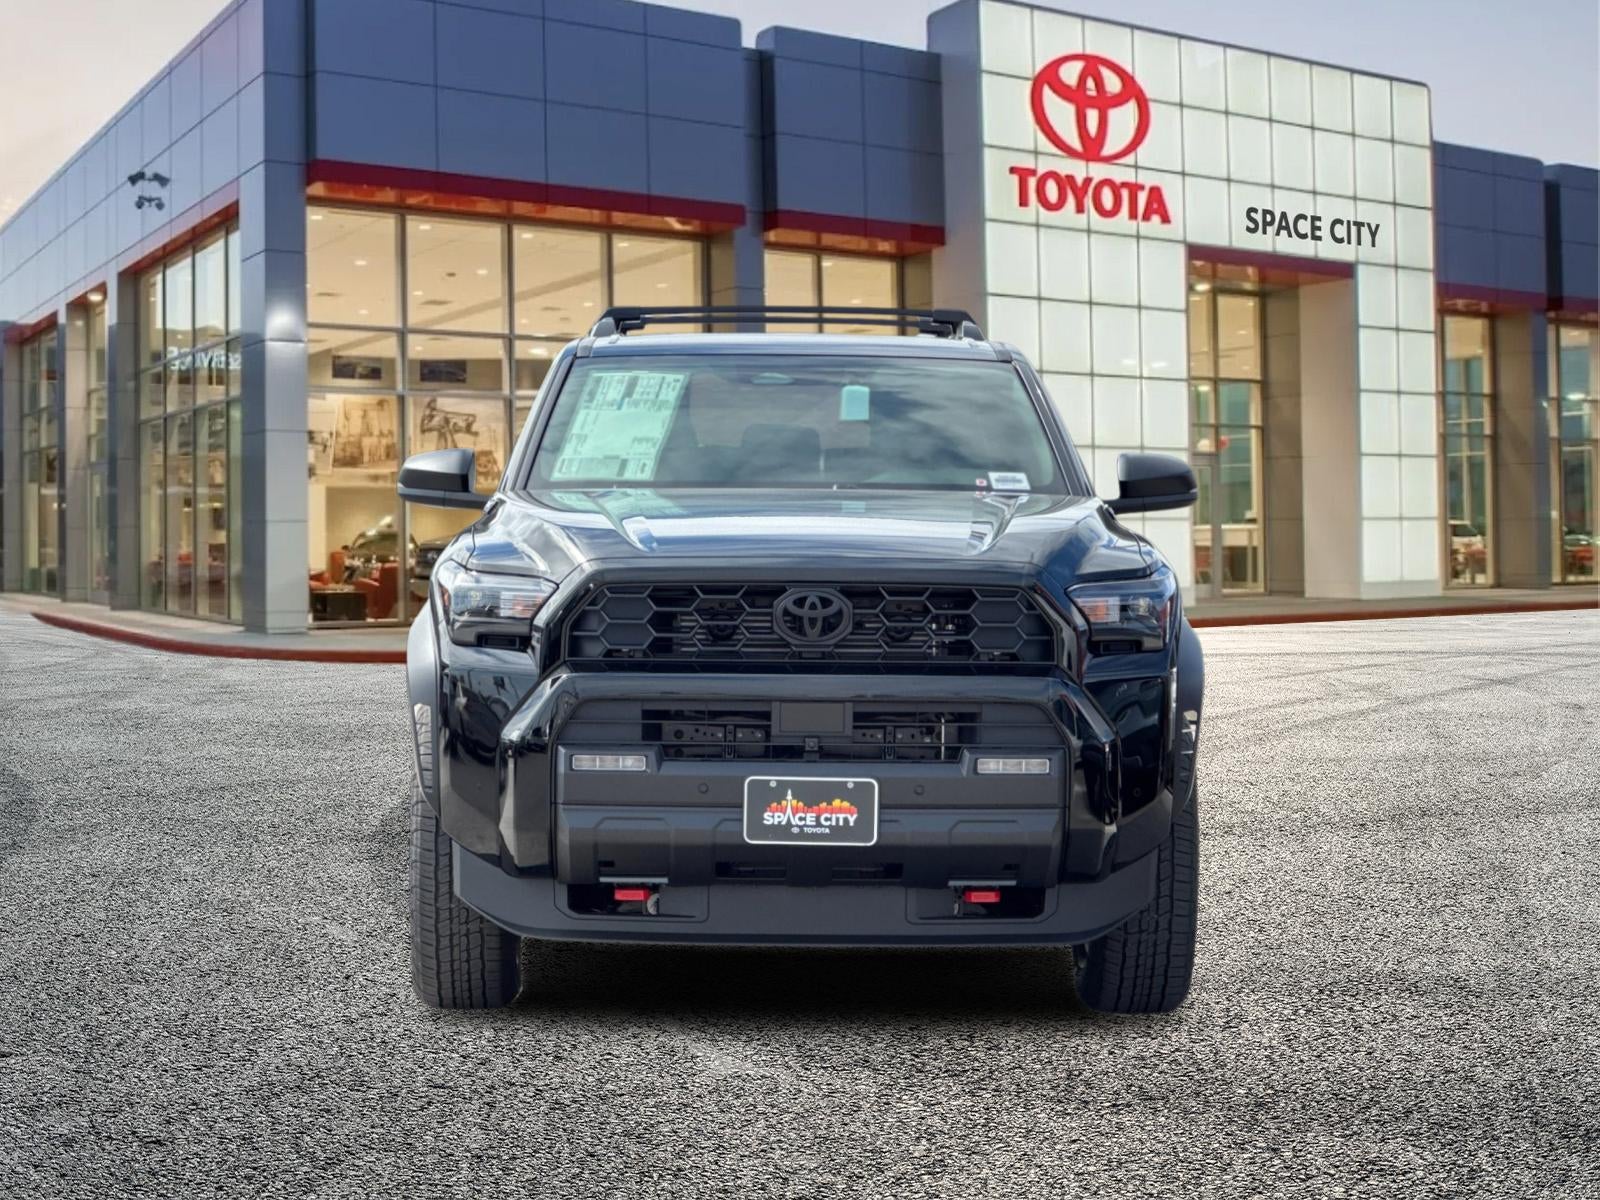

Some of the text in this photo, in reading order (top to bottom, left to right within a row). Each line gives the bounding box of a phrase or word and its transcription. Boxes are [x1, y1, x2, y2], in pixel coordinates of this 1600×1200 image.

[1010, 165, 1171, 225] TOYOTA
[1245, 206, 1381, 249] SPACE CITY
[762, 811, 858, 827] SPACE CITY
[803, 826, 830, 834] TOYOTA
